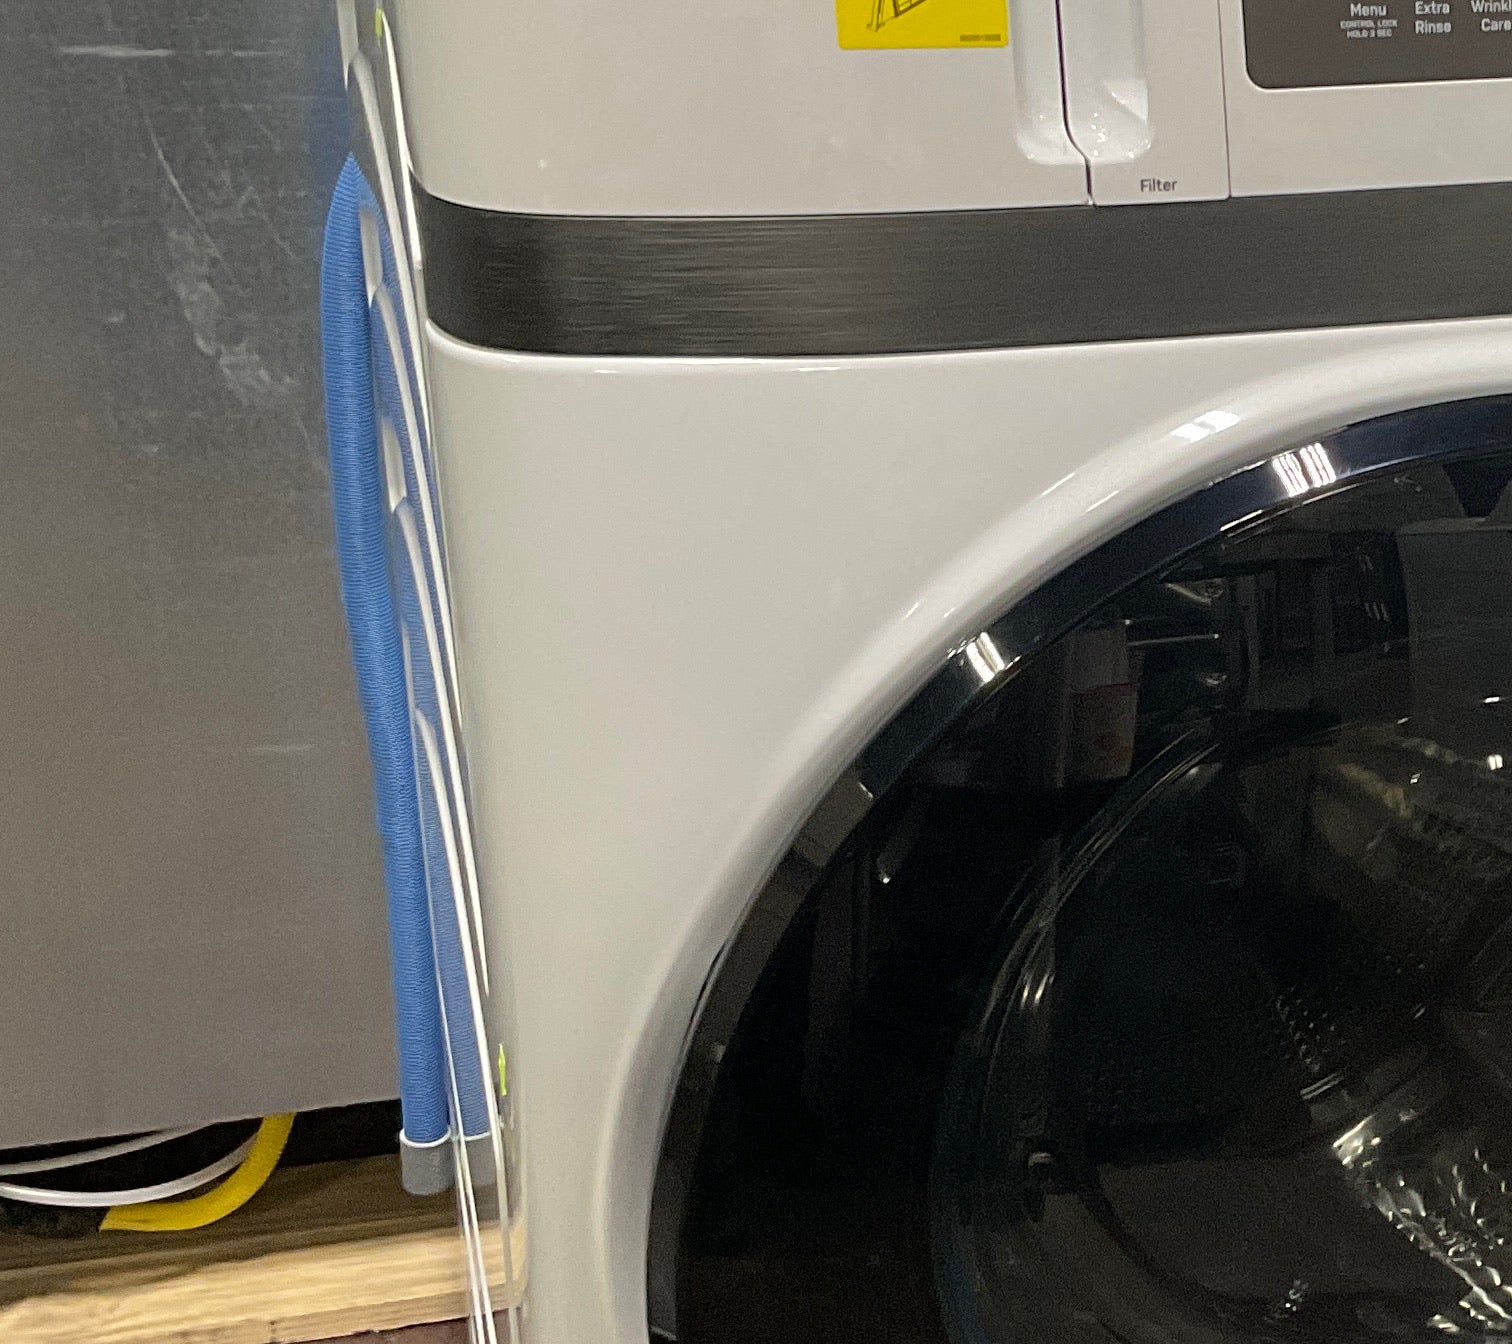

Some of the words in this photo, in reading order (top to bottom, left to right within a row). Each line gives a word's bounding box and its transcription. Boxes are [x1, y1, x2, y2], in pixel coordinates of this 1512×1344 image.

[1350, 2, 1388, 17] Menu
[1414, 0, 1450, 16] Extra
[1414, 20, 1452, 34] Rinse
[1481, 17, 1512, 32] Care
[1346, 29, 1368, 39] HOLD
[1376, 29, 1393, 38] SEC
[1140, 178, 1178, 192] Filter
